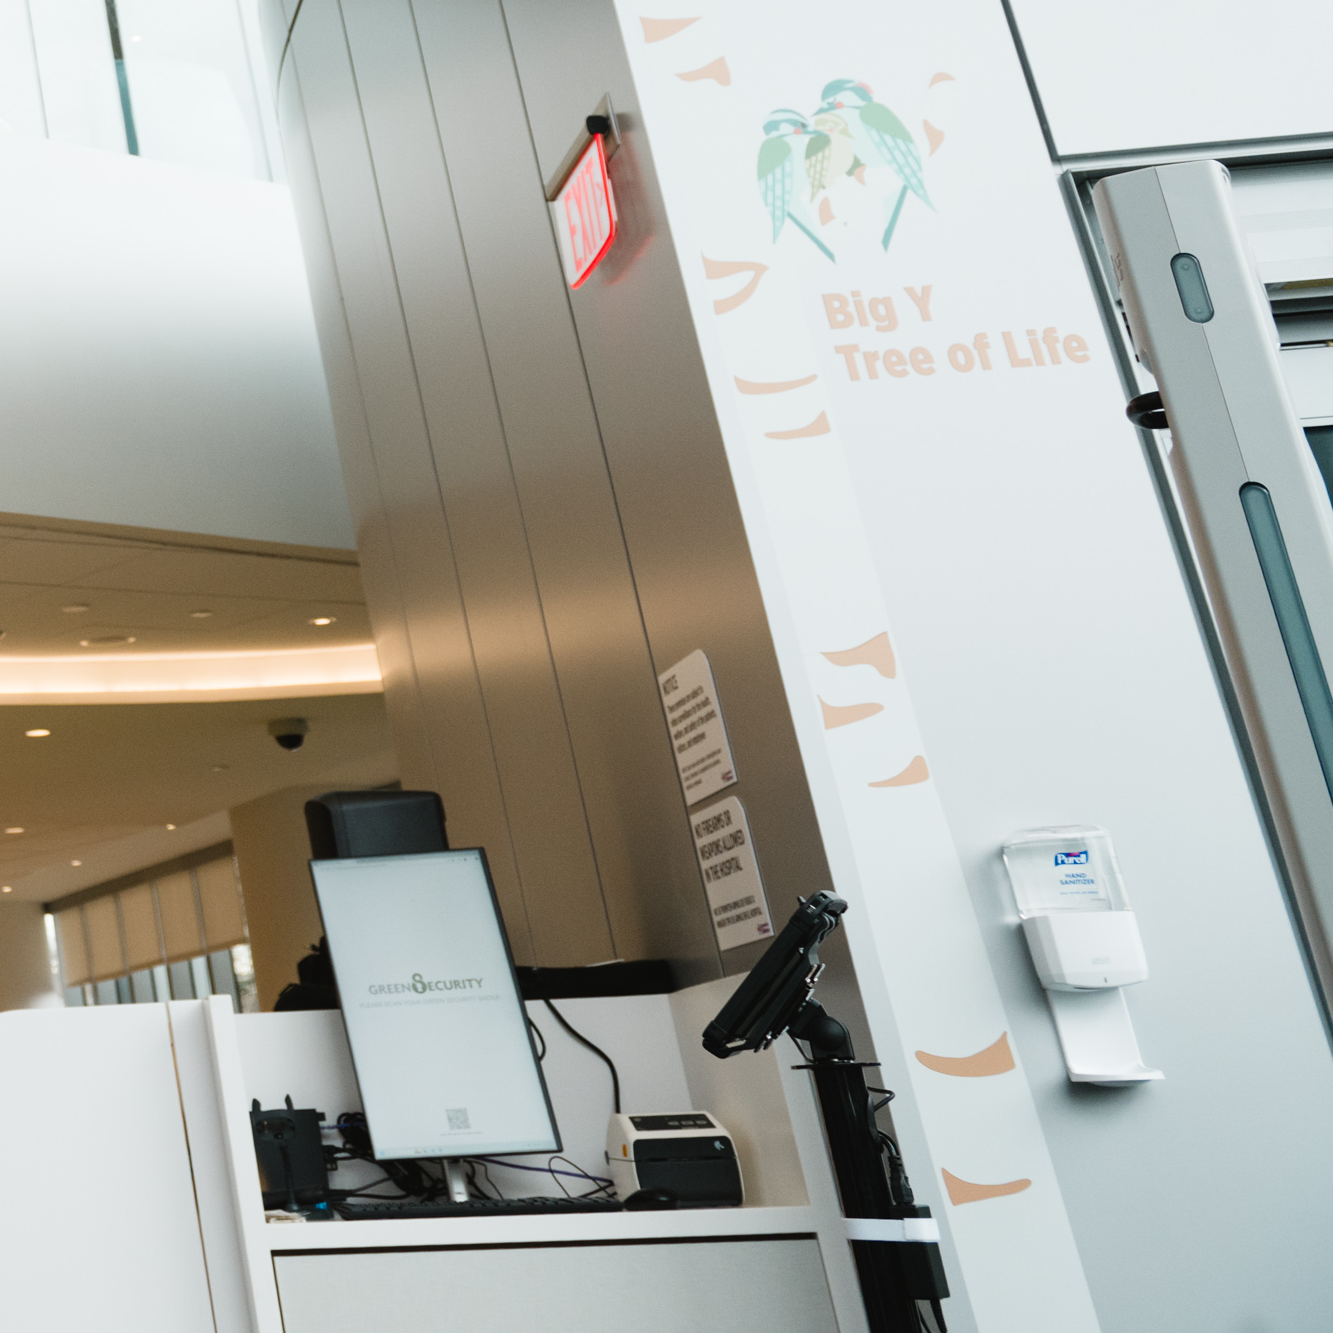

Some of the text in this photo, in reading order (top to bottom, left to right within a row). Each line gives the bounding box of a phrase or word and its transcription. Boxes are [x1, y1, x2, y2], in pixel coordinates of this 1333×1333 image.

[564, 156, 603, 274] EXIT
[821, 285, 933, 333] Big Y
[834, 326, 1092, 382] Tree of Life
